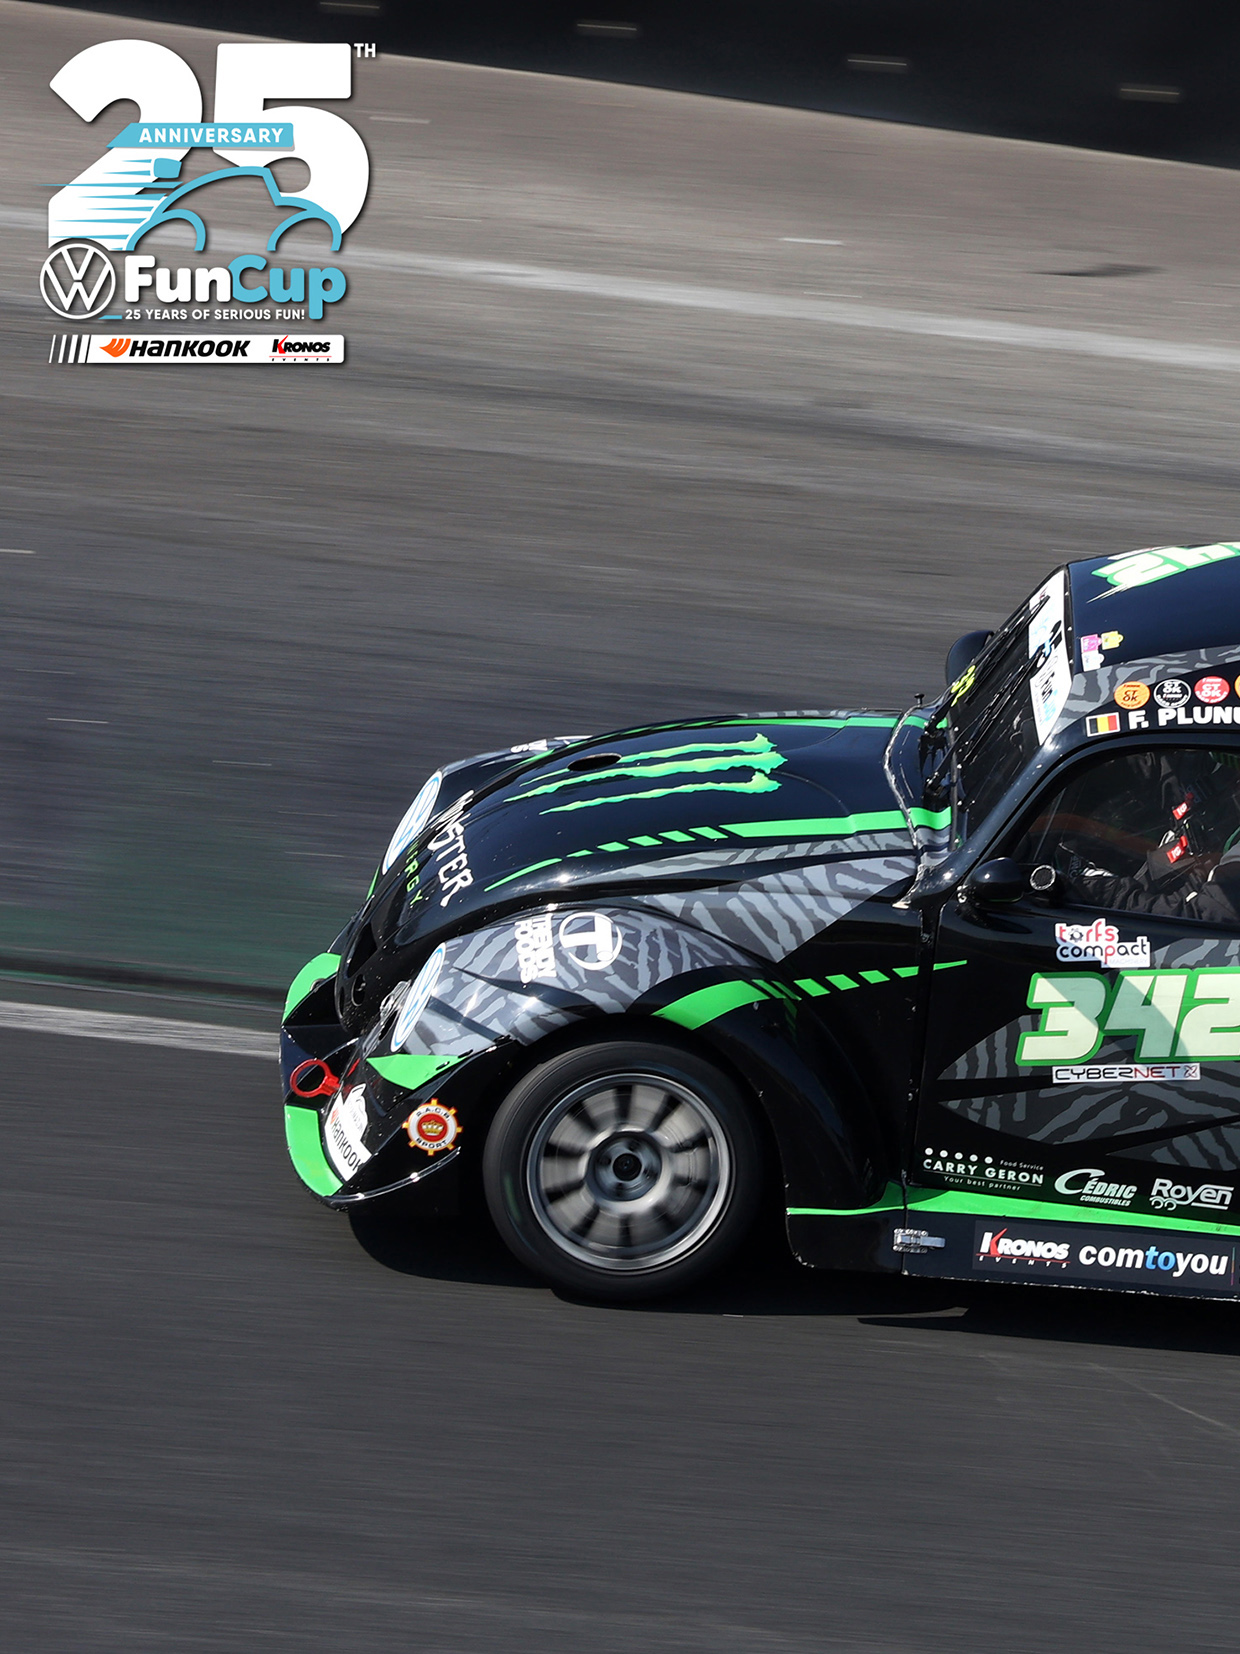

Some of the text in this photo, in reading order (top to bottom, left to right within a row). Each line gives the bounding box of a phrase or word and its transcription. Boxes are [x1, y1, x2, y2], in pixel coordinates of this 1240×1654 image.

[1128, 709, 1149, 730] F.
[1060, 938, 1147, 965] compact
[1055, 1066, 1181, 1080] CYBERNET
[416, 1137, 448, 1149] SPORT
[923, 1158, 1044, 1185] CARRY GERON
[1019, 1161, 1044, 1171] Service
[944, 1175, 1021, 1191] Your best partner
[1151, 1178, 1234, 1208] Royen
[1079, 1194, 1132, 1207] COMBUSTIBLES
[979, 1228, 1071, 1260] KRONOS
[1079, 1245, 1229, 1278] comtoyou
